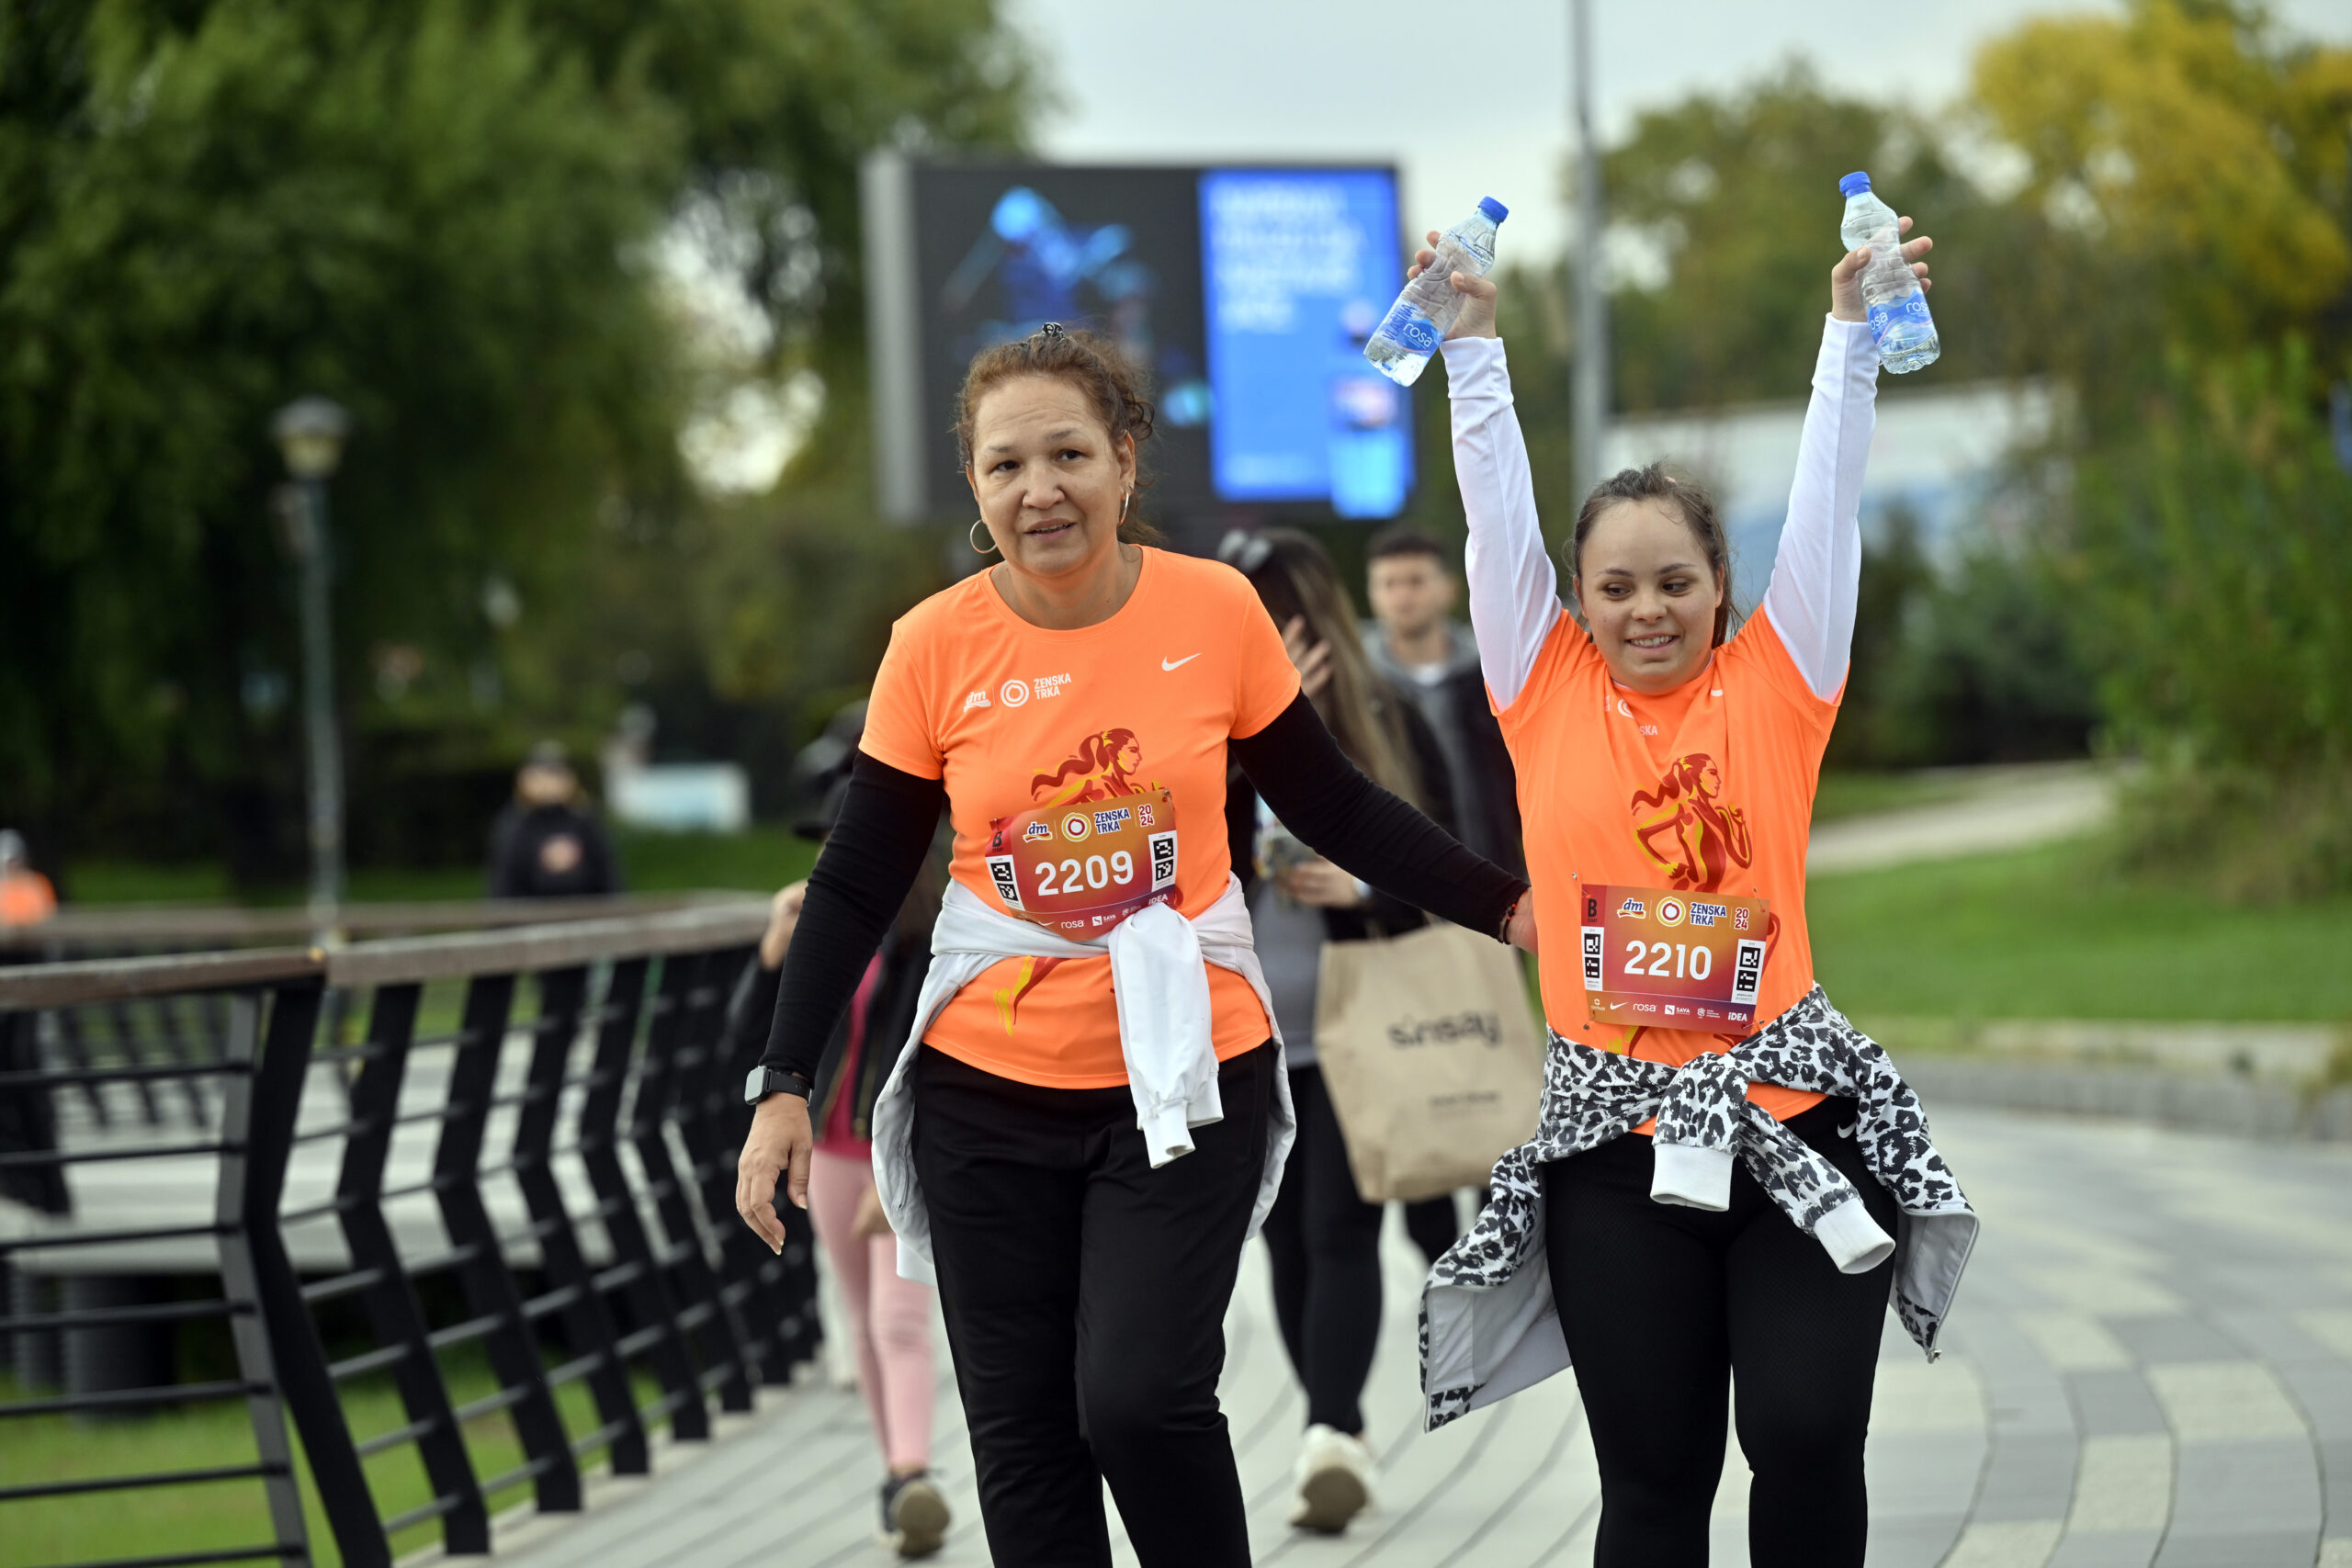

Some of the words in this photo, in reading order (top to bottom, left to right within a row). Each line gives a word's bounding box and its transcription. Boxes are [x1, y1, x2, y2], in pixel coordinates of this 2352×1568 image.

[1906, 301, 1928, 313] ros
[1870, 311, 1888, 331] osa
[1403, 323, 1433, 348] rosa
[965, 691, 987, 705] dm
[1034, 686, 1061, 700] TRKA
[1640, 725, 1658, 736] SKA
[1138, 805, 1152, 816] 20
[1095, 820, 1121, 834] TRKA
[1140, 815, 1154, 826] 24
[1028, 822, 1049, 835] dm
[992, 830, 1002, 847] B
[1035, 851, 1134, 897] 2209
[1588, 898, 1598, 918] B
[1623, 898, 1644, 911] dm
[1690, 914, 1714, 926] TRKA
[1736, 908, 1749, 919] 20
[1060, 919, 1085, 930] rosa
[1735, 919, 1747, 930] 24
[1623, 940, 1713, 981] 2210
[1633, 1003, 1657, 1012] rosa
